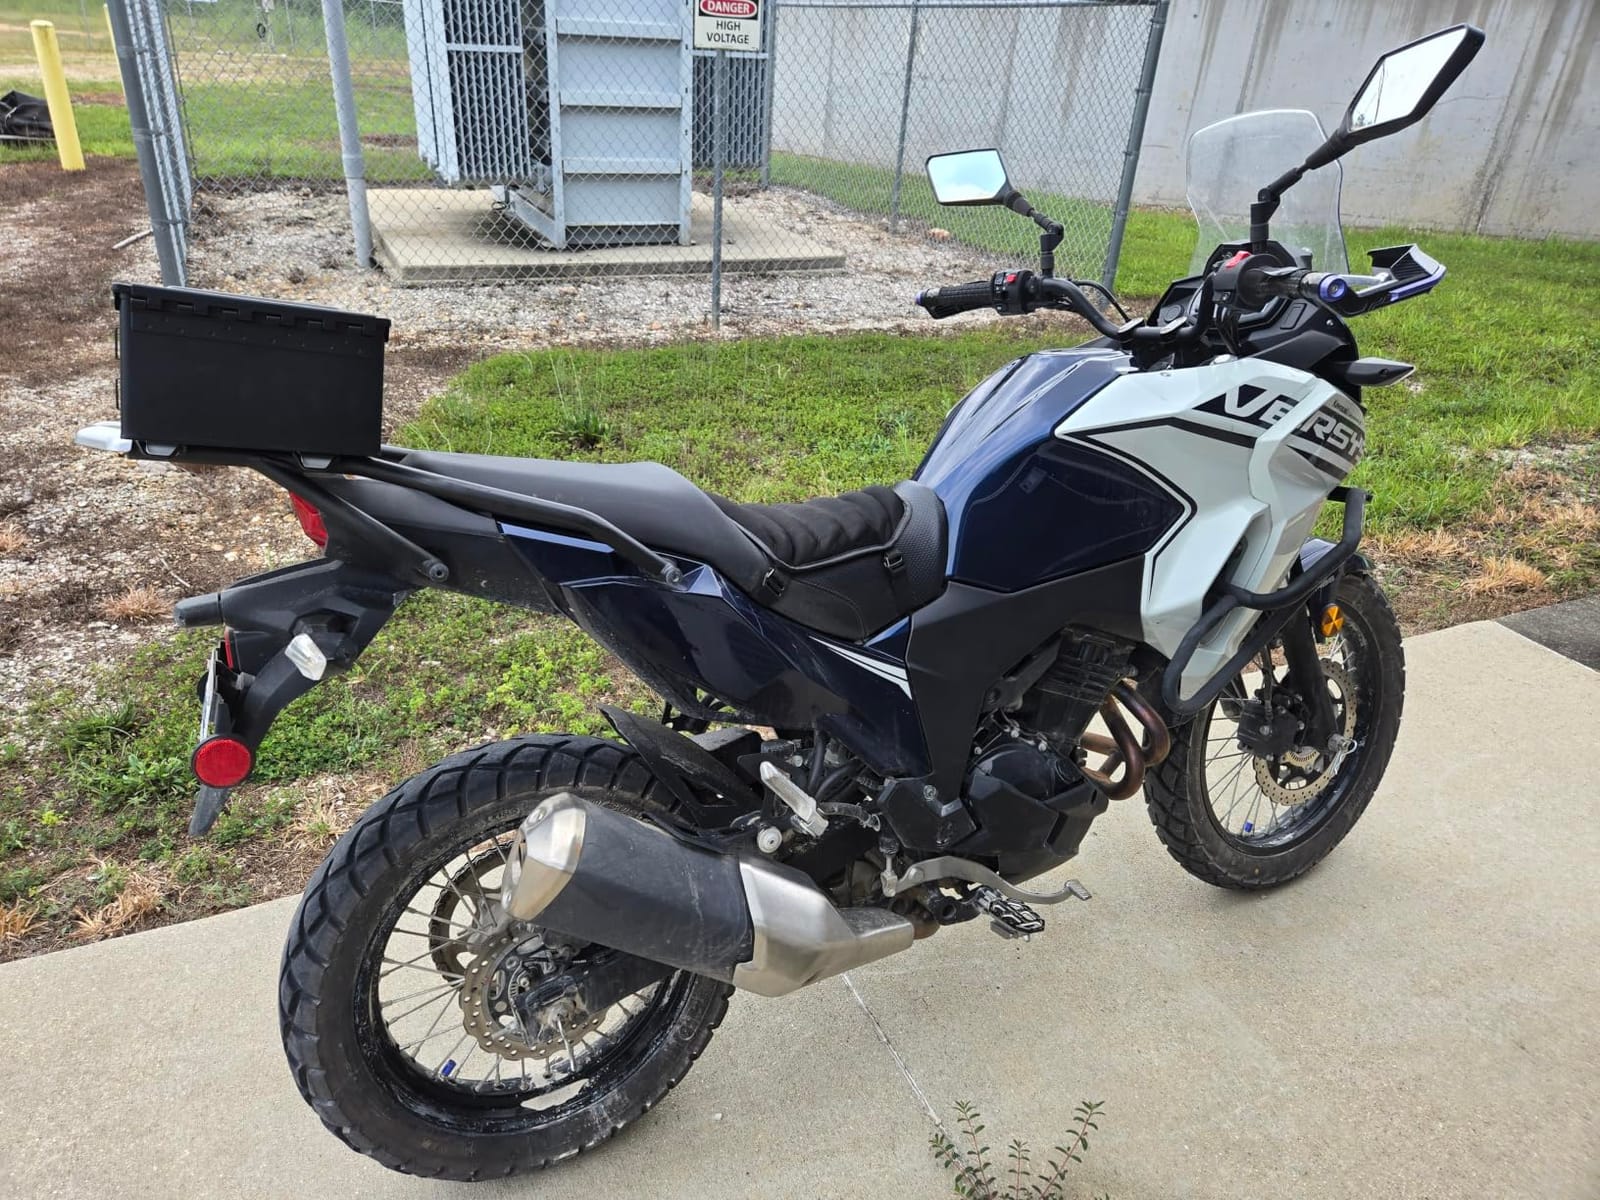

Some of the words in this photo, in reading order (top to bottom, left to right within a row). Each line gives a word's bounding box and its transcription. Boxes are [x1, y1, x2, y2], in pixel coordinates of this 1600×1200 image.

[707, 0, 750, 14] DANGER
[716, 20, 741, 31] HIGH
[706, 32, 750, 44] VOLTAGE
